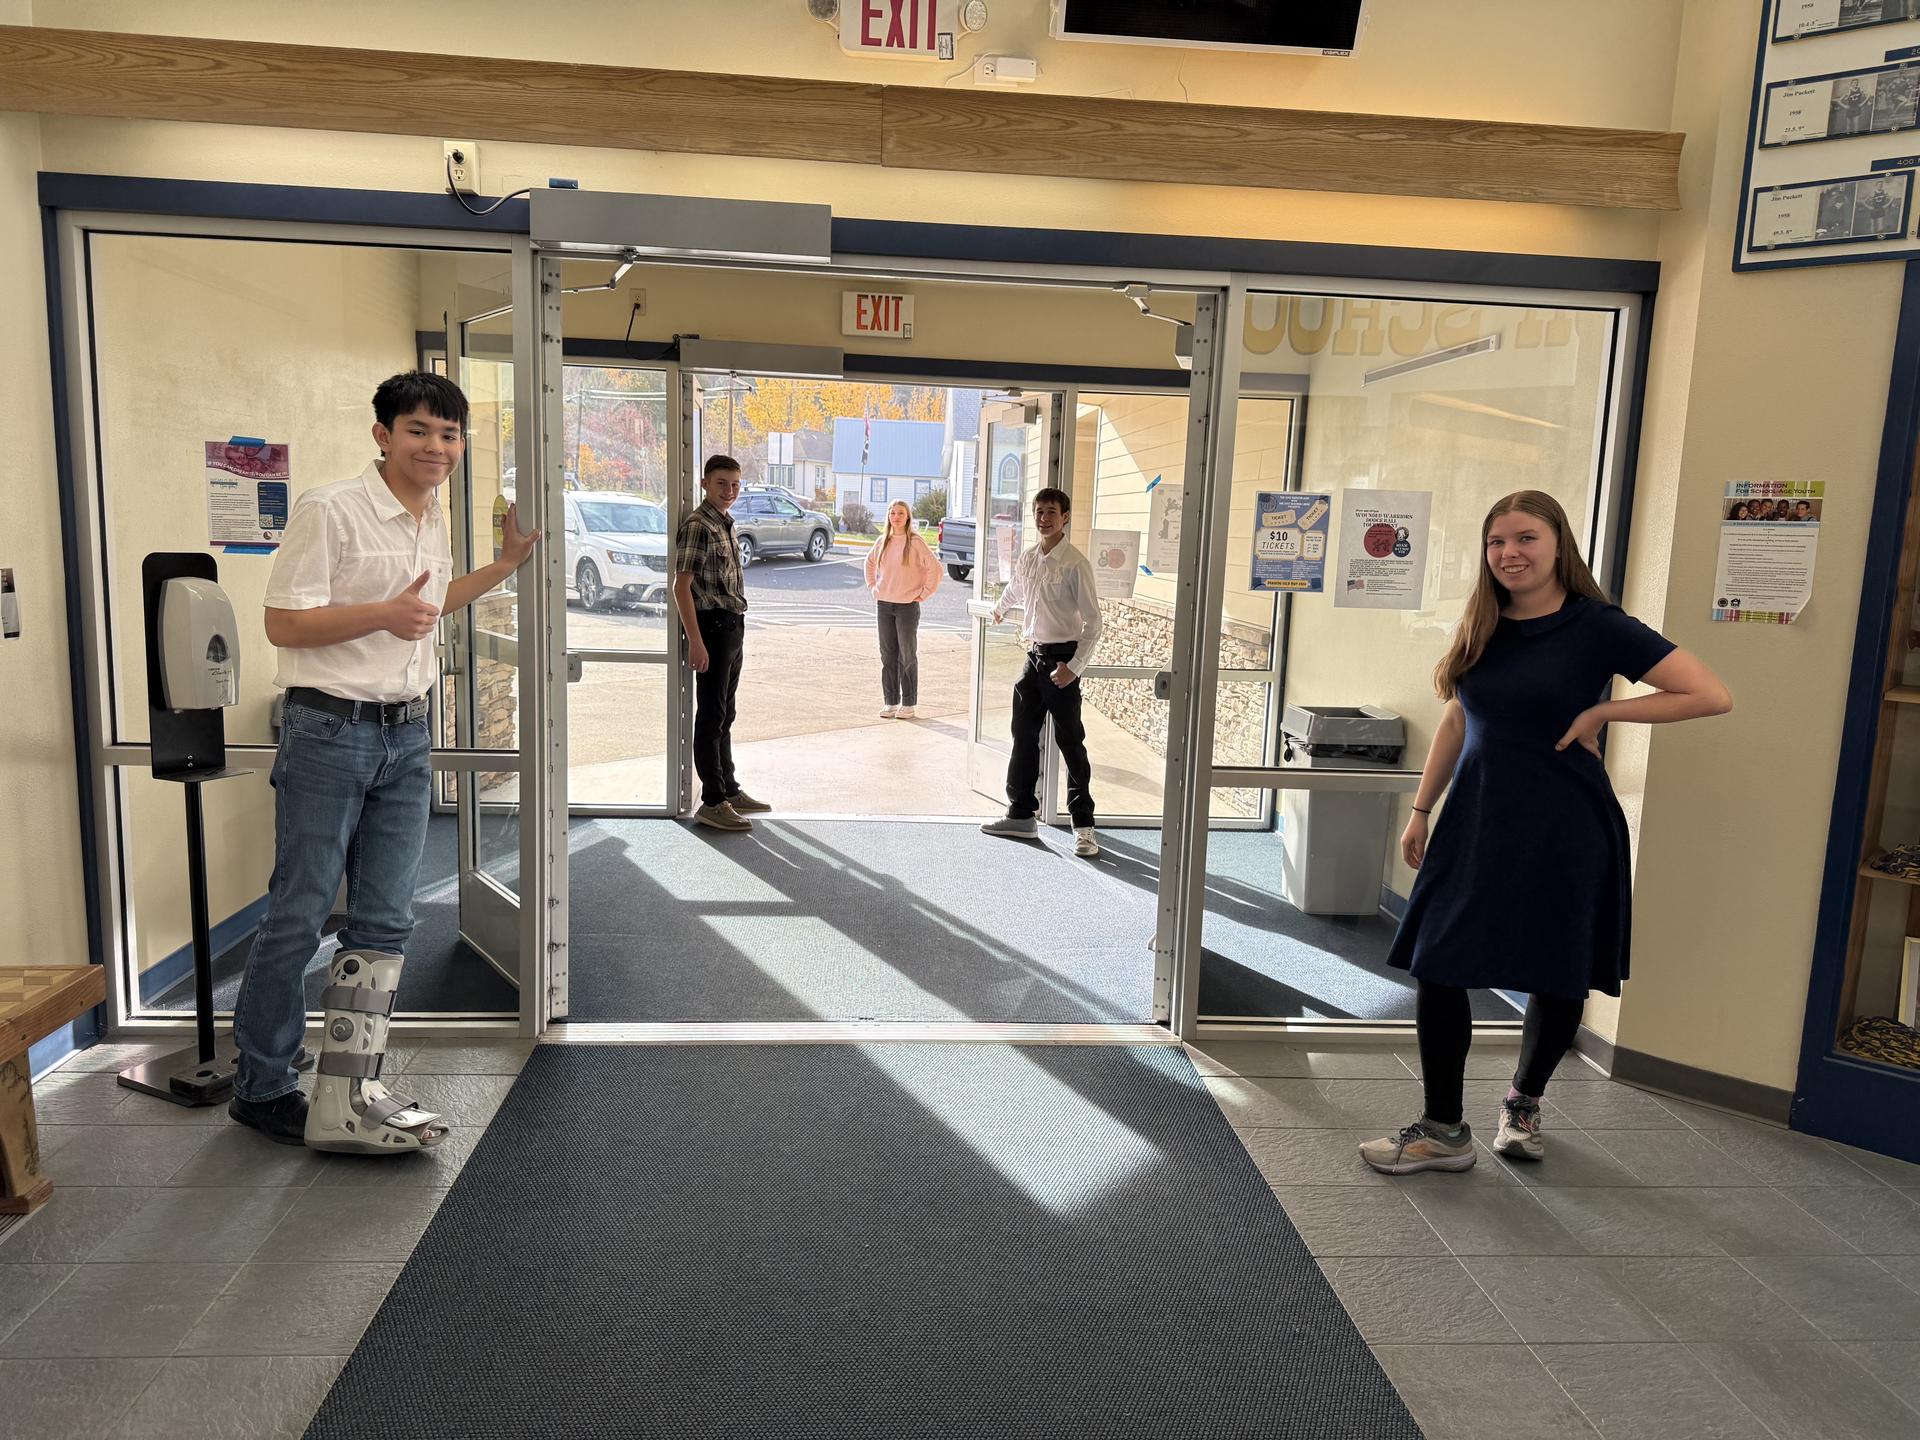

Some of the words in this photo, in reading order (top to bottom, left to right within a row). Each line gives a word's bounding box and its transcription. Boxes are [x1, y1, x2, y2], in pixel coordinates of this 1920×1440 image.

[861, 0, 937, 50] EXIT
[856, 294, 904, 332] EXIT
[1262, 542, 1295, 550] TICKETS
[1269, 531, 1288, 541] $10
